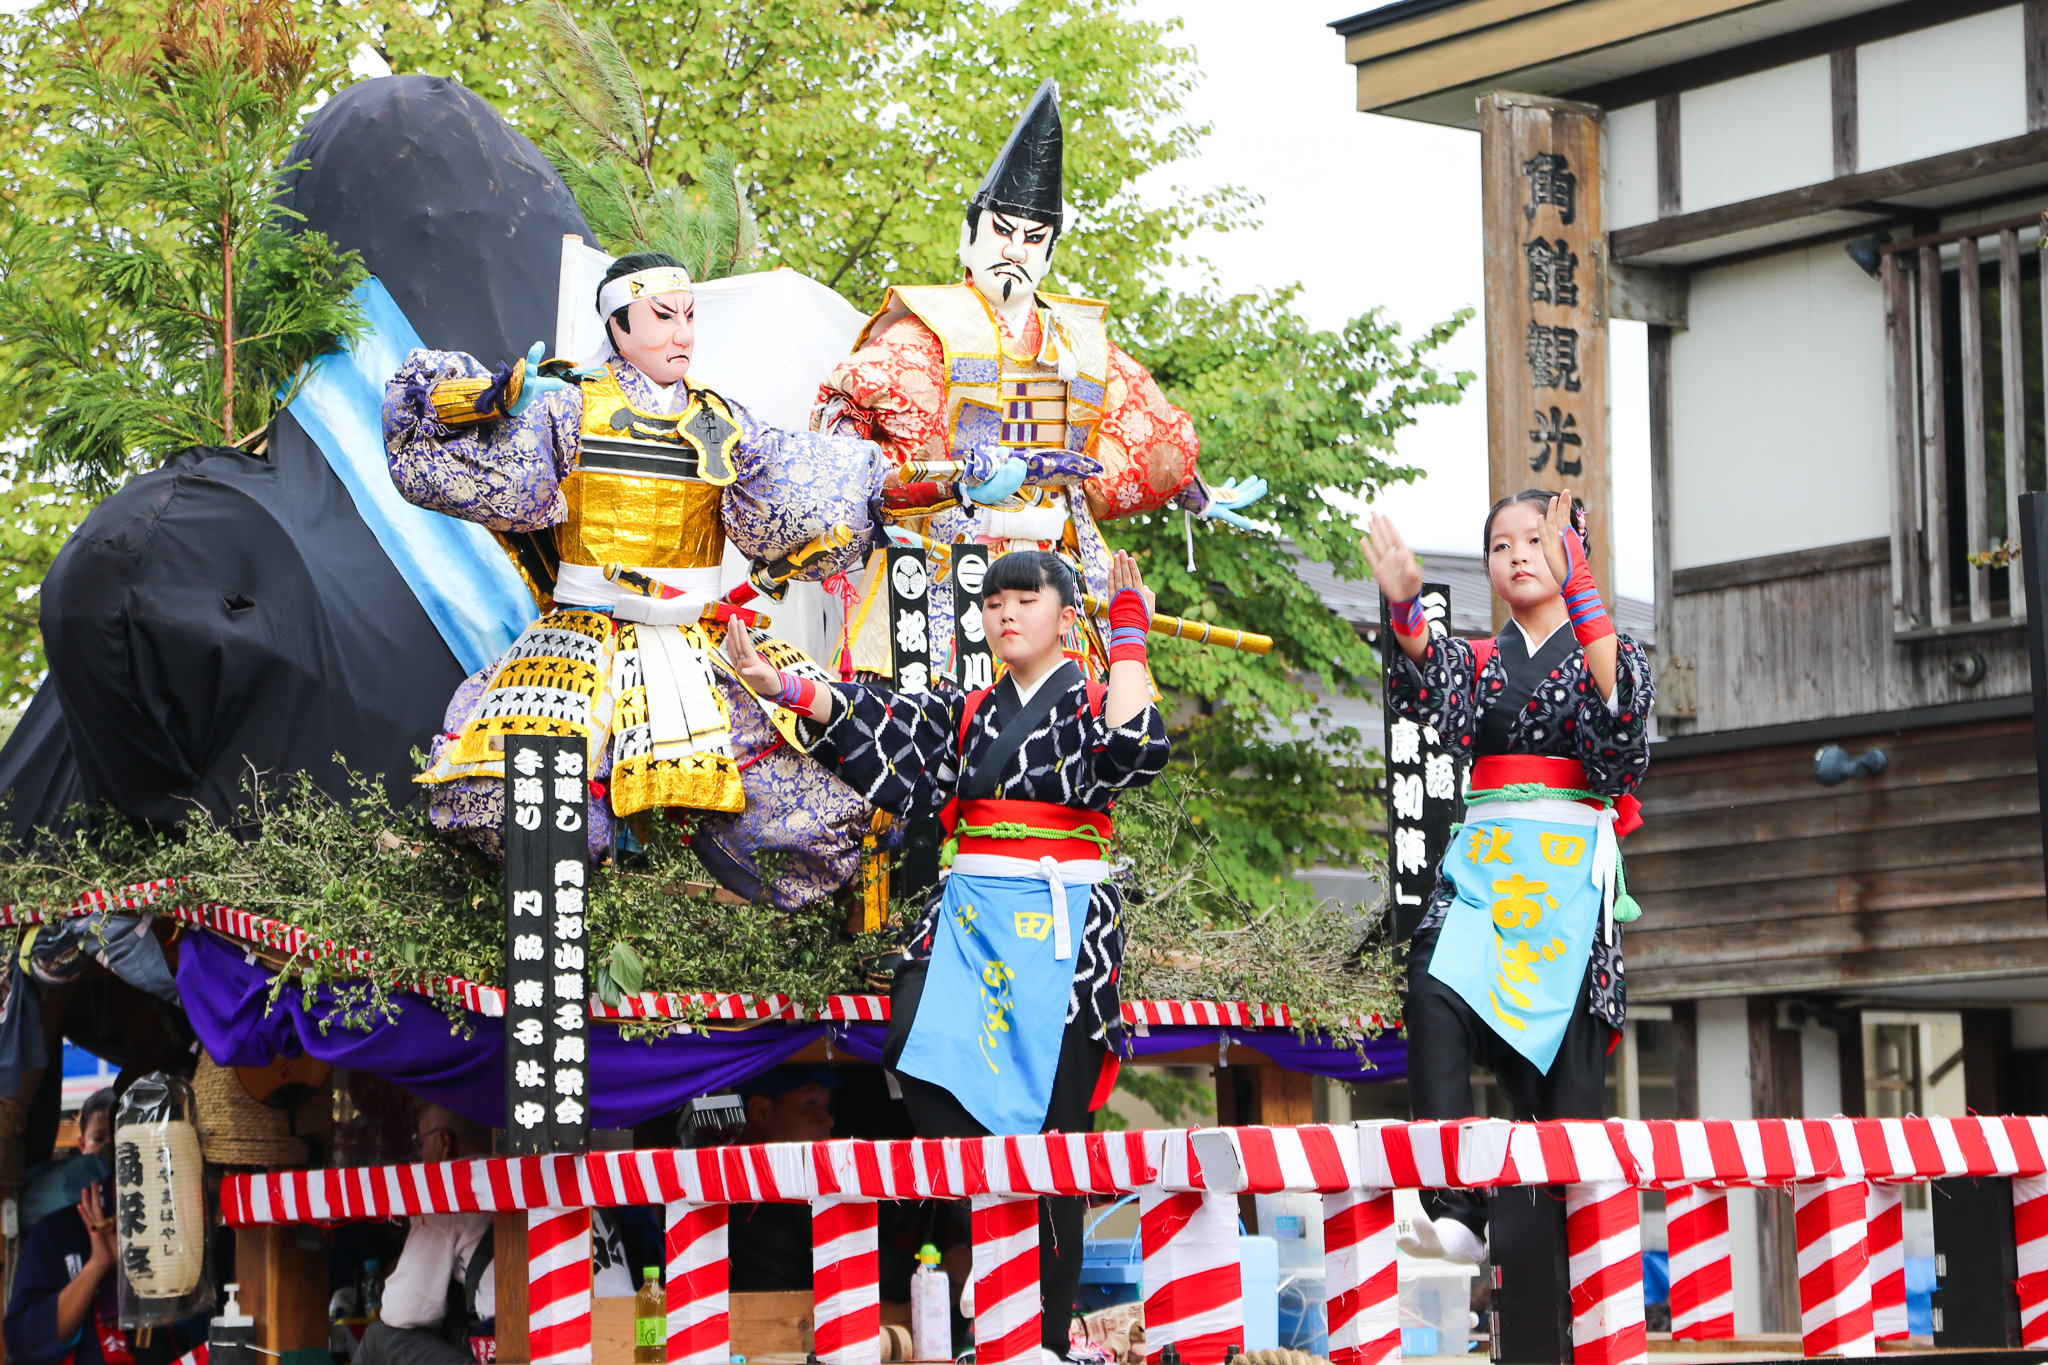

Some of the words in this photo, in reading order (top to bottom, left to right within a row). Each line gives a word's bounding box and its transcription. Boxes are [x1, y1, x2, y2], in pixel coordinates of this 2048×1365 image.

[1523, 151, 1584, 508] 角館観光
[513, 747, 544, 831] 手踊り
[554, 749, 583, 832] お囃し
[1467, 826, 1587, 866] 秋田
[1488, 873, 1567, 1031] おばこ
